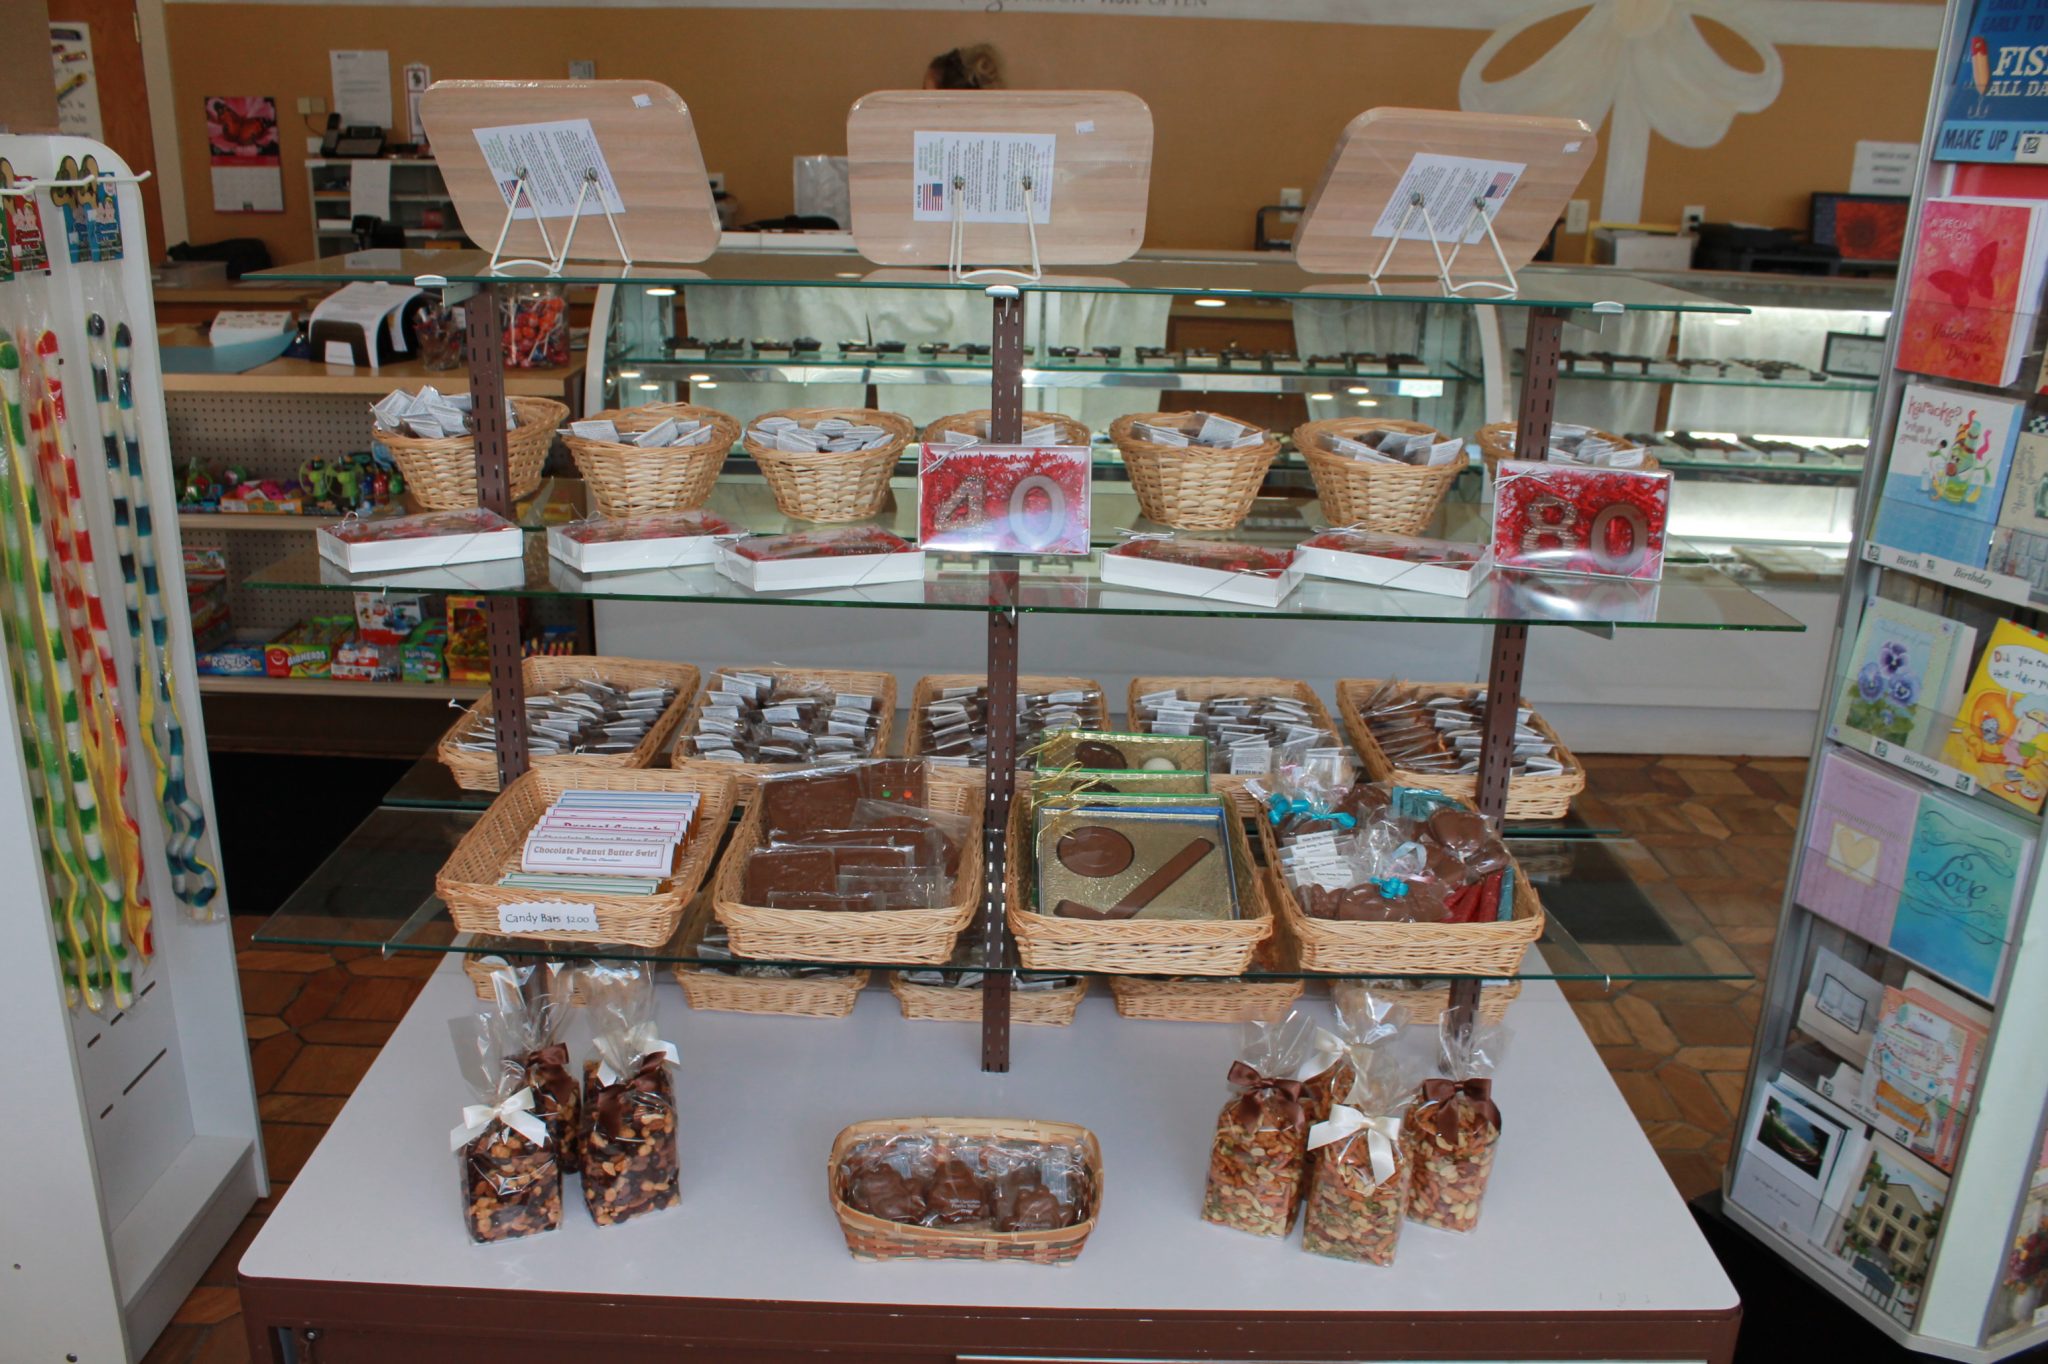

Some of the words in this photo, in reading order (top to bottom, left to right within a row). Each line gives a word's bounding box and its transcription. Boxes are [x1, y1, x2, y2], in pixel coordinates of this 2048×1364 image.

[1991, 45, 2048, 77] FIS
[1985, 80, 2020, 97] ALL
[2024, 81, 2048, 97] DA
[1941, 128, 1984, 150] MAKE
[1987, 130, 2009, 152] UP
[1520, 494, 1651, 574] 80
[1896, 555, 1920, 570] Birth
[1953, 567, 1993, 589] Birthday
[1902, 754, 1940, 777] Birthday
[533, 845, 574, 856] Chocolate
[576, 846, 606, 857] Peanut
[607, 848, 634, 858] Butter
[635, 849, 658, 858] Swirl
[1915, 855, 1988, 908] Love
[505, 912, 538, 925] Candy
[540, 913, 561, 924] Bars
